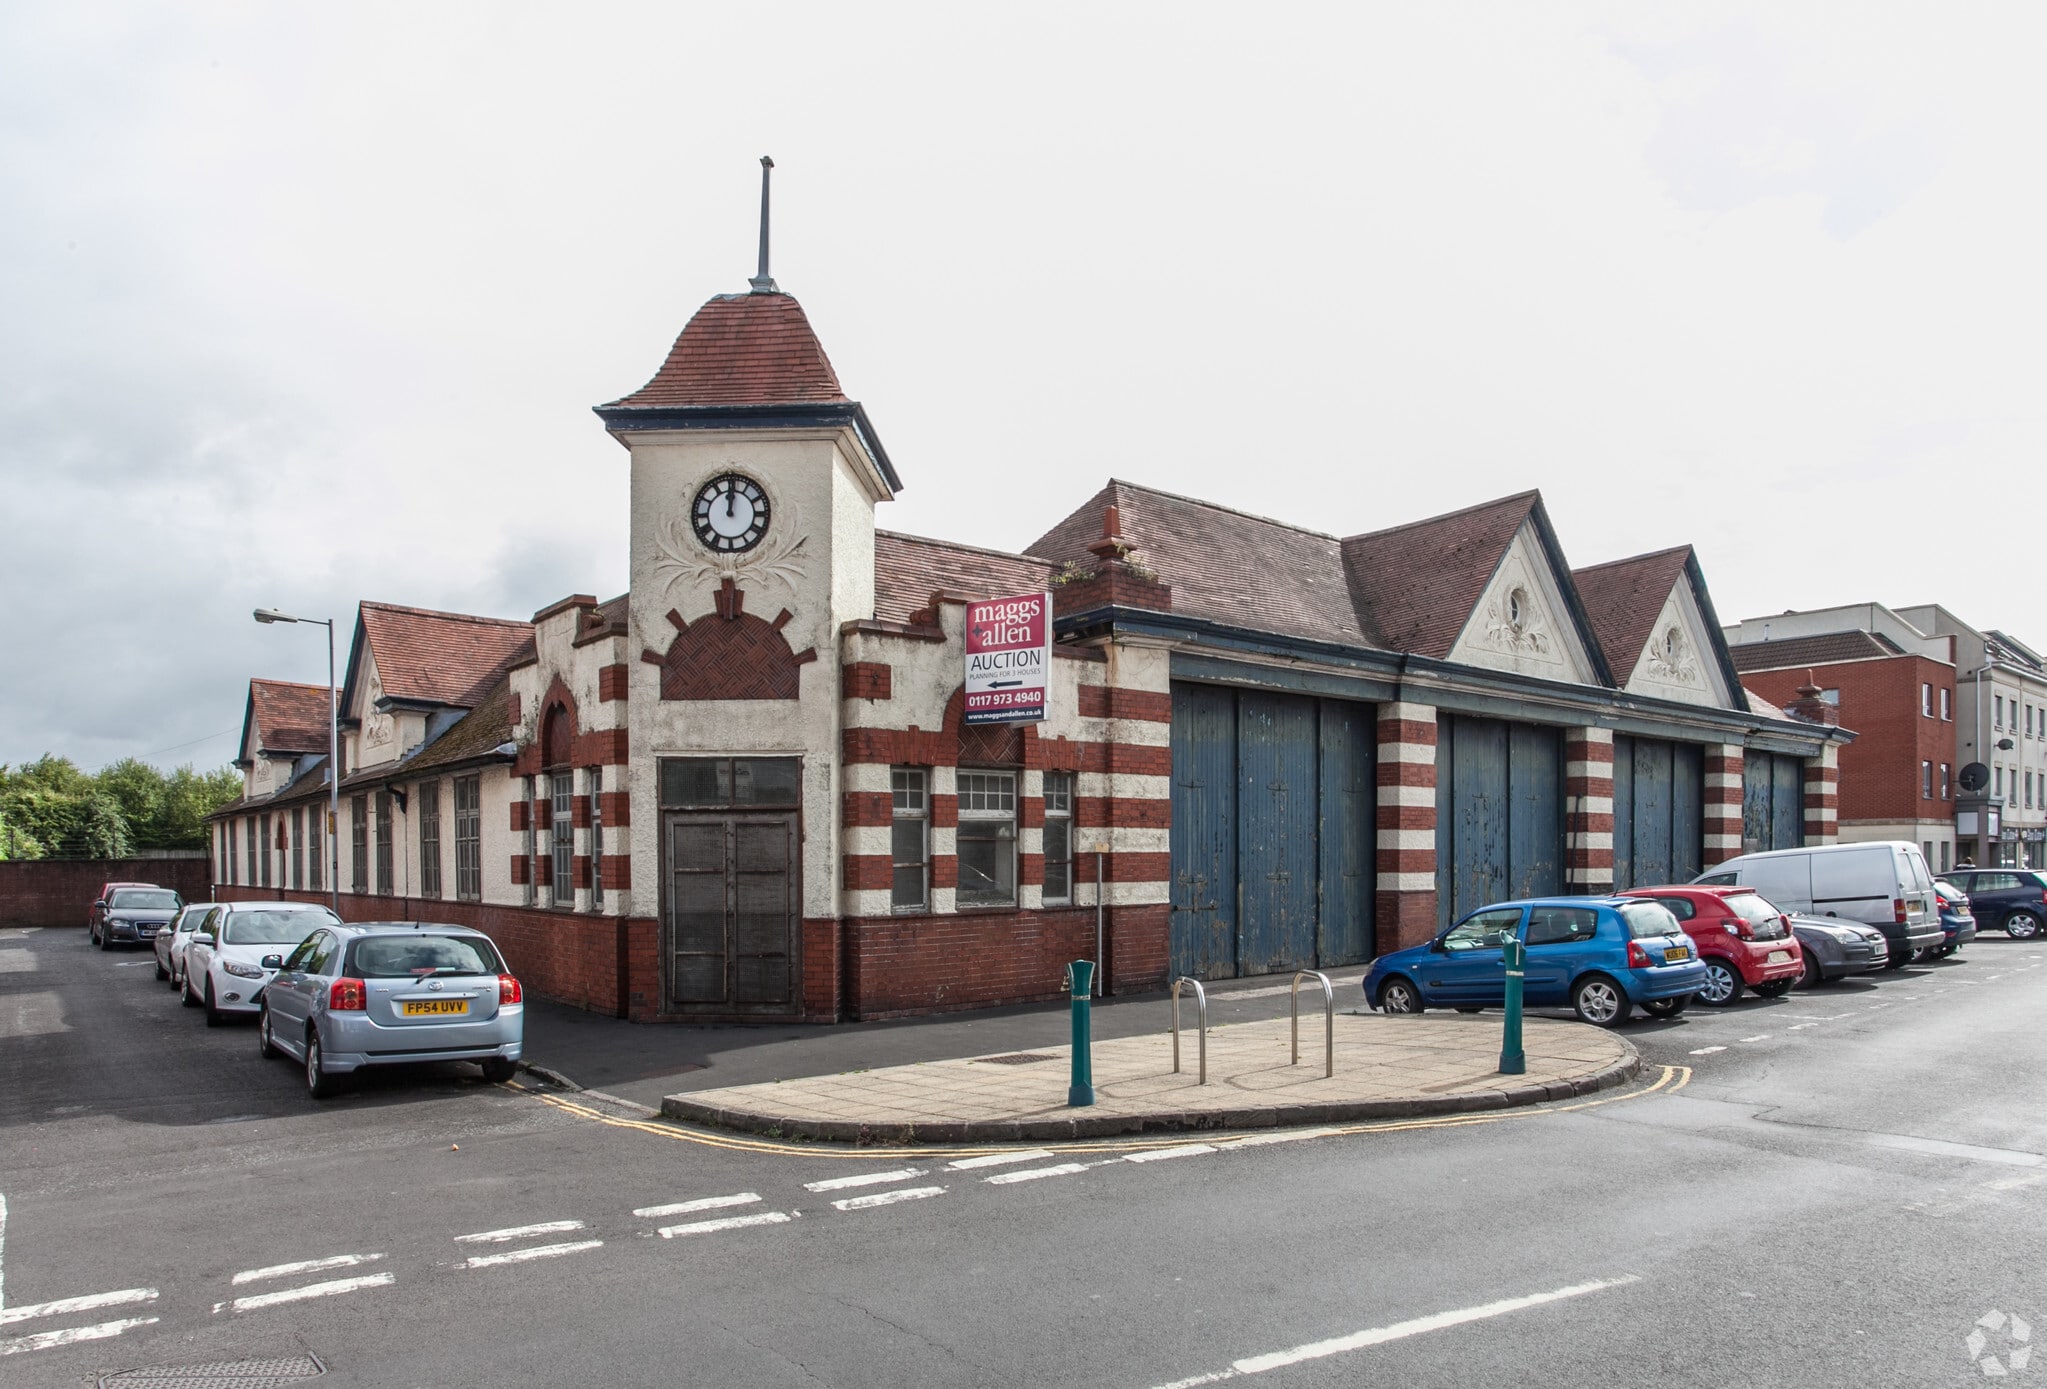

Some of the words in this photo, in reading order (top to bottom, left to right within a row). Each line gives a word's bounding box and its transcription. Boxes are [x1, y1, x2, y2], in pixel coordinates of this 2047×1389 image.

[974, 599, 1040, 625] maggs
[982, 623, 1032, 647] allen
[970, 649, 1041, 671] AUCTION
[969, 671, 998, 680] PLANNING
[999, 670, 1011, 678] FOR
[1017, 668, 1041, 676] HOUSES
[968, 695, 992, 707] 0117
[993, 693, 1013, 705] 973
[1014, 691, 1041, 703] 4940
[967, 709, 1042, 719] www.maggsandallen.co.uk
[407, 1001, 438, 1013] FP54
[441, 1001, 463, 1012] UVV
